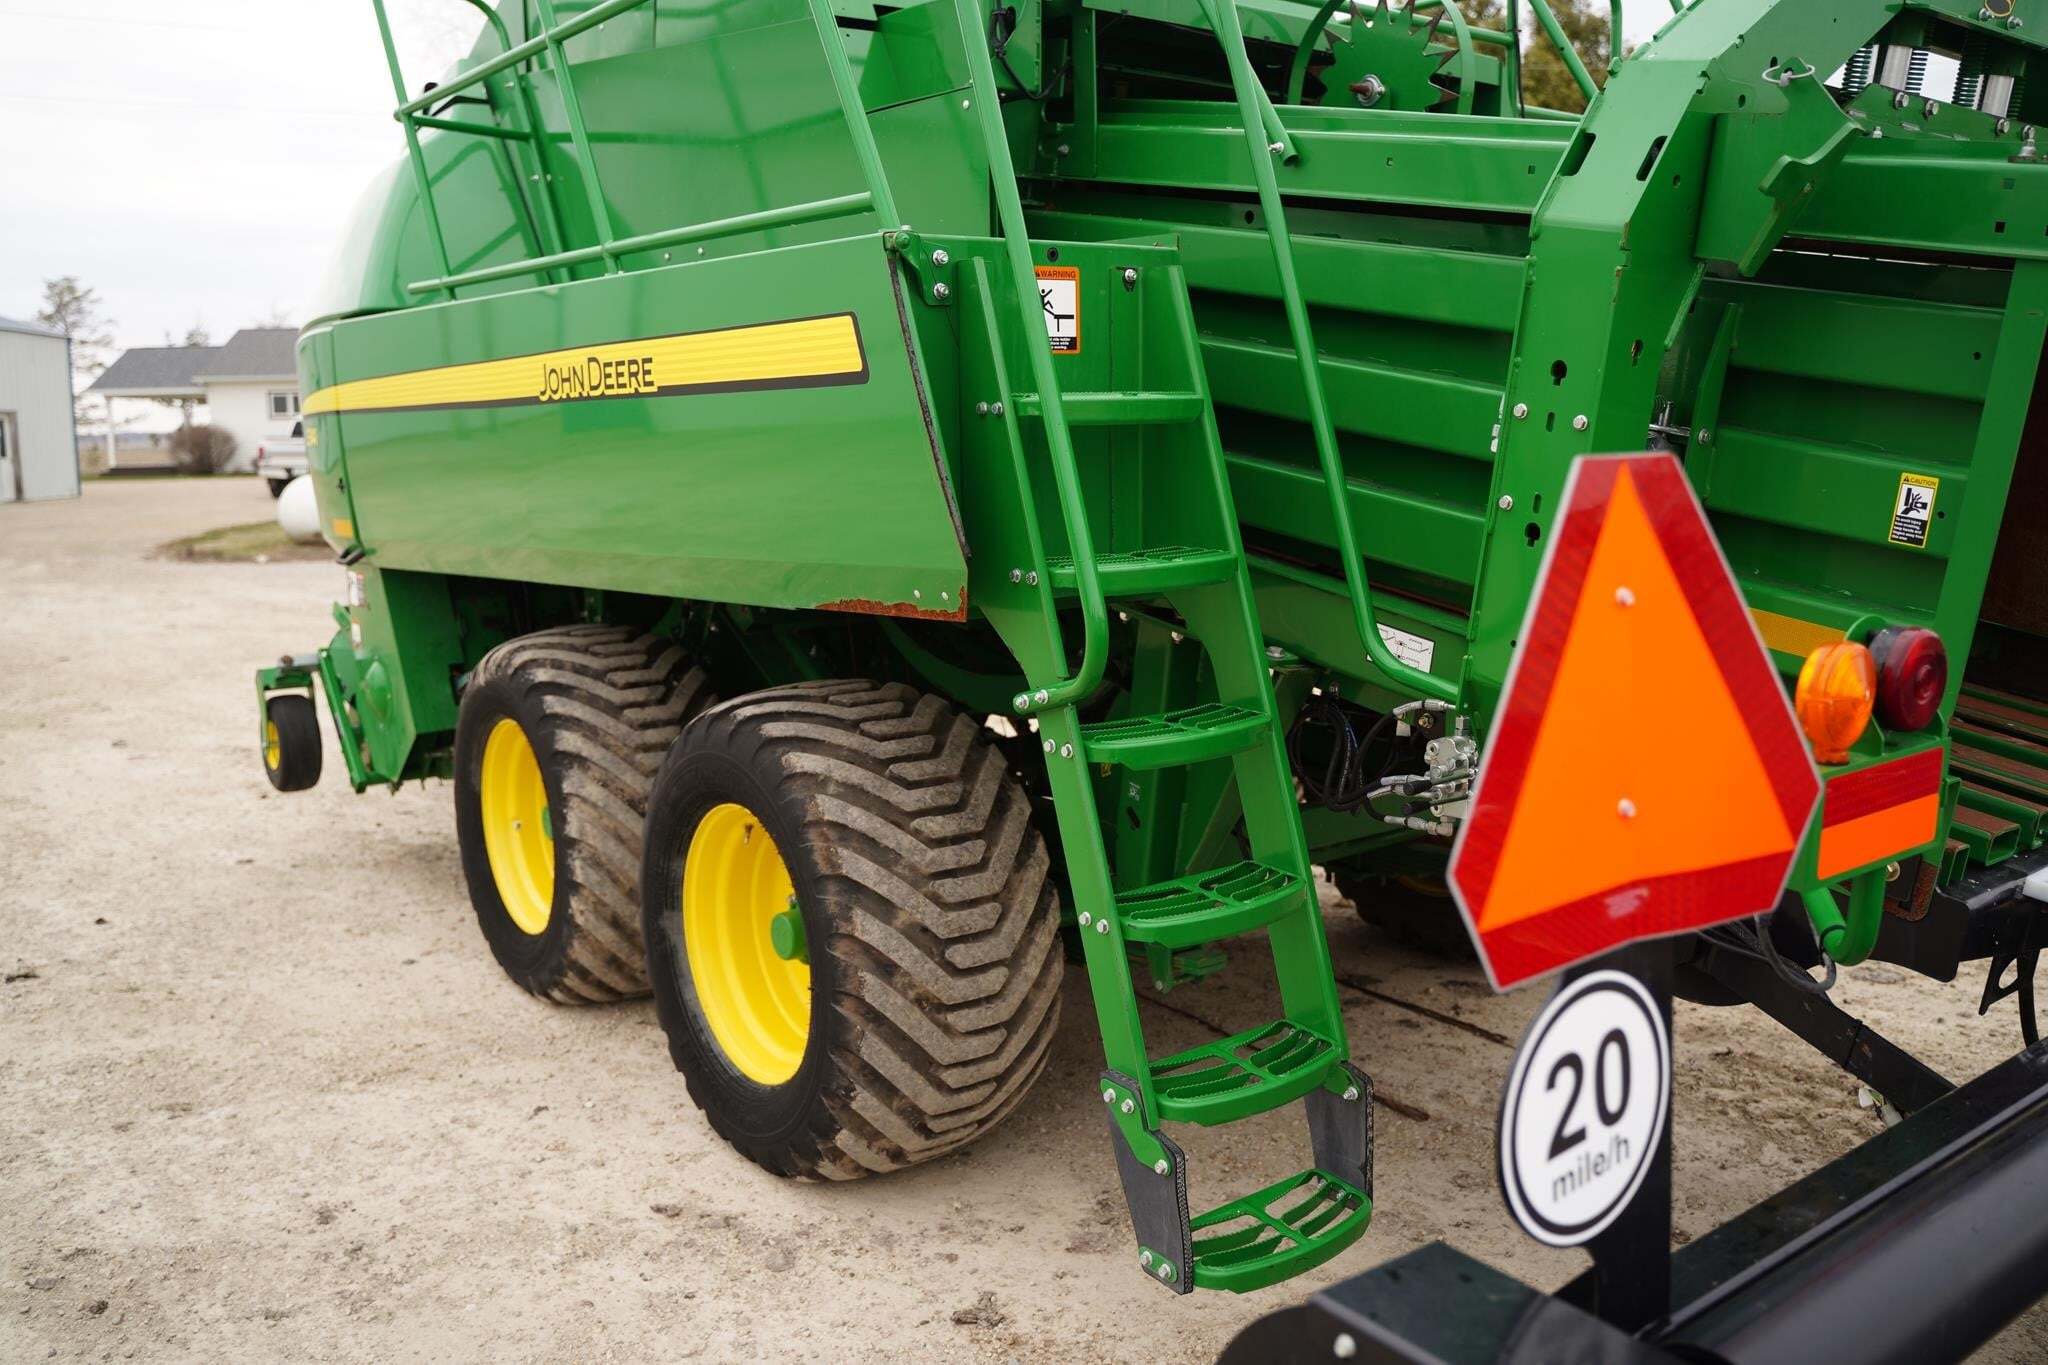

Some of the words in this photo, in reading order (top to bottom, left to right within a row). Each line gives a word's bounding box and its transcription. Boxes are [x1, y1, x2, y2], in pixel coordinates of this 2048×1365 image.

[1040, 270, 1076, 279] WARNING
[540, 363, 585, 396] JOHN
[587, 356, 655, 391] DEERE
[1910, 477, 1937, 488] CAUTION
[1545, 1028, 1631, 1162] 20
[1551, 1133, 1630, 1202] mile/h
